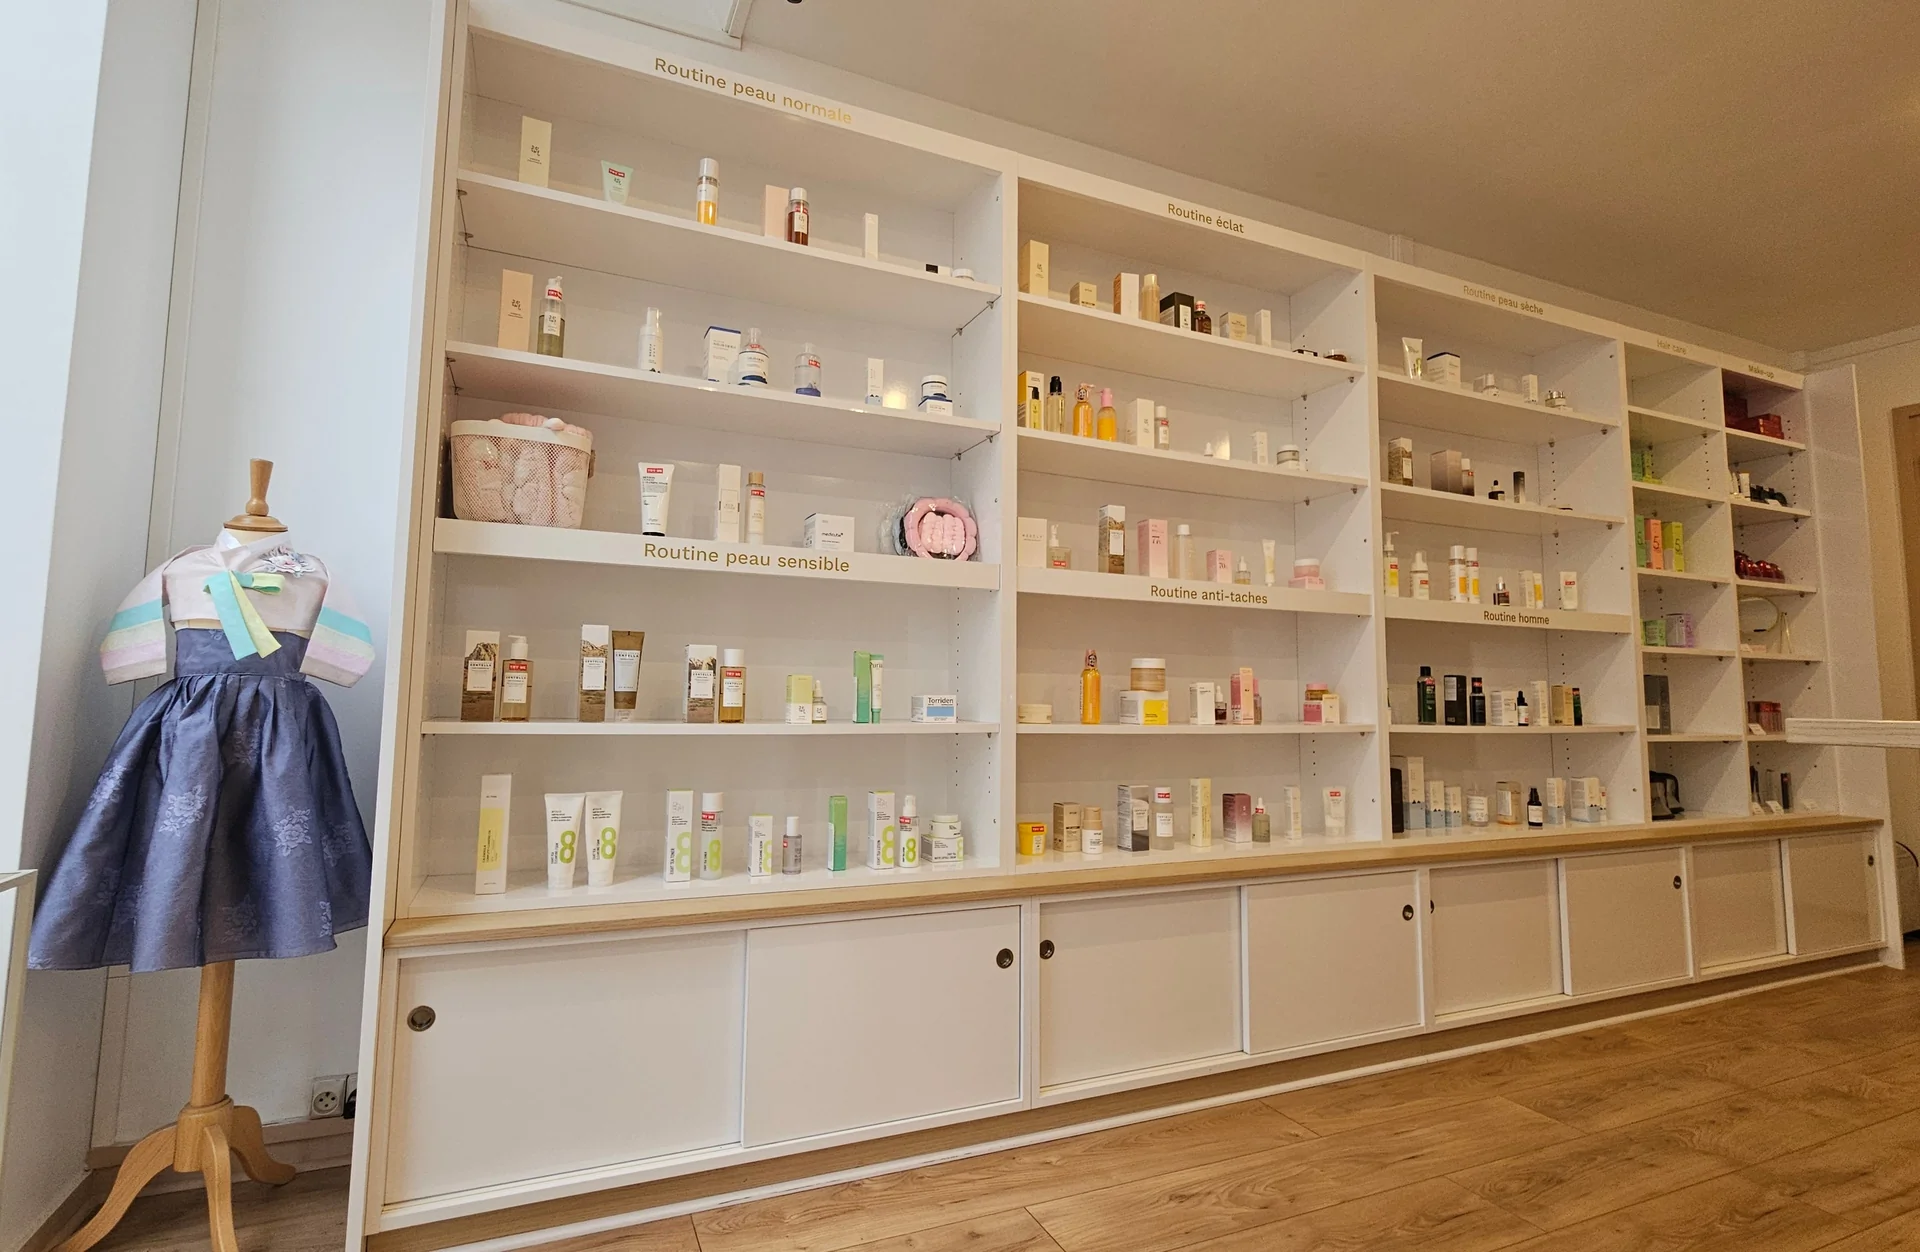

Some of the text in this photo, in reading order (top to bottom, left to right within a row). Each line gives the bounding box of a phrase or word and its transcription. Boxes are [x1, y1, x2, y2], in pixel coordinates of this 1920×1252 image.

[654, 57, 852, 124] Routine peau normale
[1167, 203, 1245, 234] Routine éclat
[1463, 285, 1544, 316] Routine peau sèche
[1748, 364, 1775, 380] Make-up
[644, 543, 850, 572] Routine peau sensible
[1652, 536, 1660, 550] 5
[1674, 538, 1682, 552] 5
[1151, 585, 1268, 605] Routine anti-taches
[1483, 610, 1550, 625] Routine homme
[559, 830, 576, 864] 8
[600, 826, 617, 860] 8
[674, 831, 692, 874] 8
[708, 839, 721, 872] 8
[906, 838, 917, 863] 8
